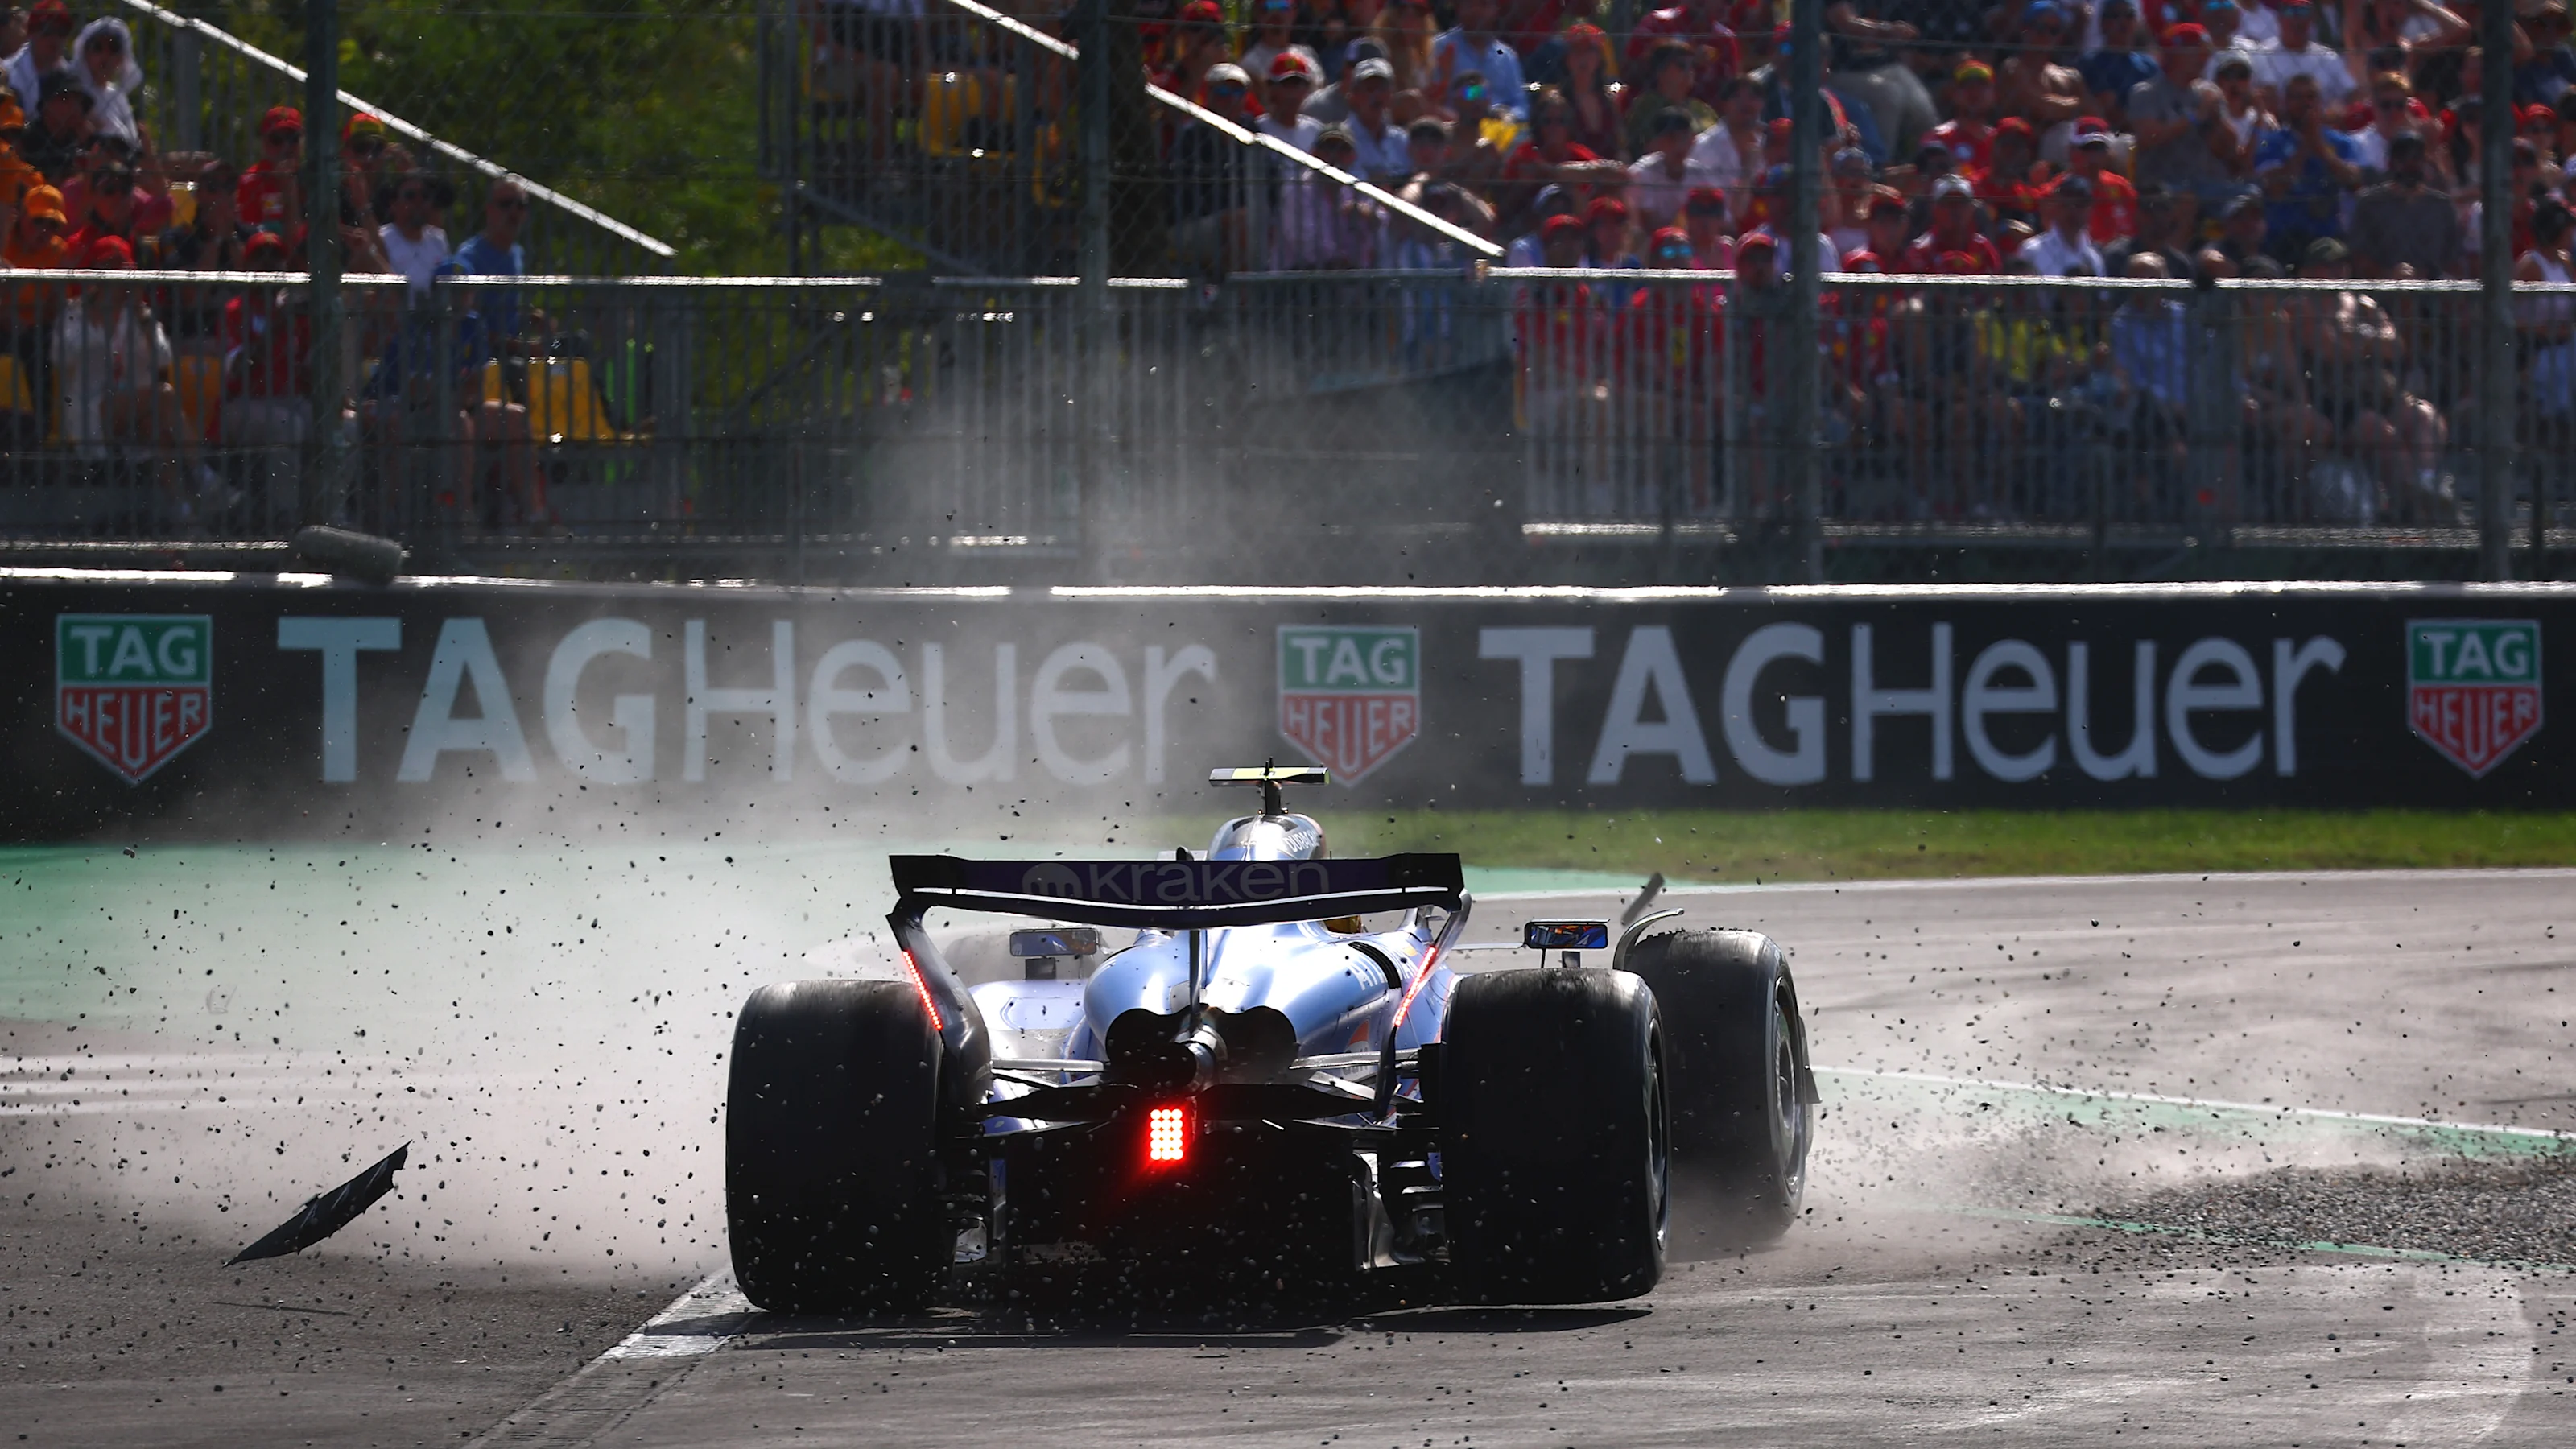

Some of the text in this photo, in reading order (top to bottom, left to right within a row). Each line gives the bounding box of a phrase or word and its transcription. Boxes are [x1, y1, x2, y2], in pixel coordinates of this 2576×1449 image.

[69, 627, 198, 677] TAG
[1290, 638, 1407, 684] TAG
[2421, 632, 2529, 677] TAG
[65, 692, 202, 770] HEUER
[1287, 699, 1412, 773] HEUER
[2416, 693, 2536, 762] HEUER
[1088, 861, 1329, 902] kraken
